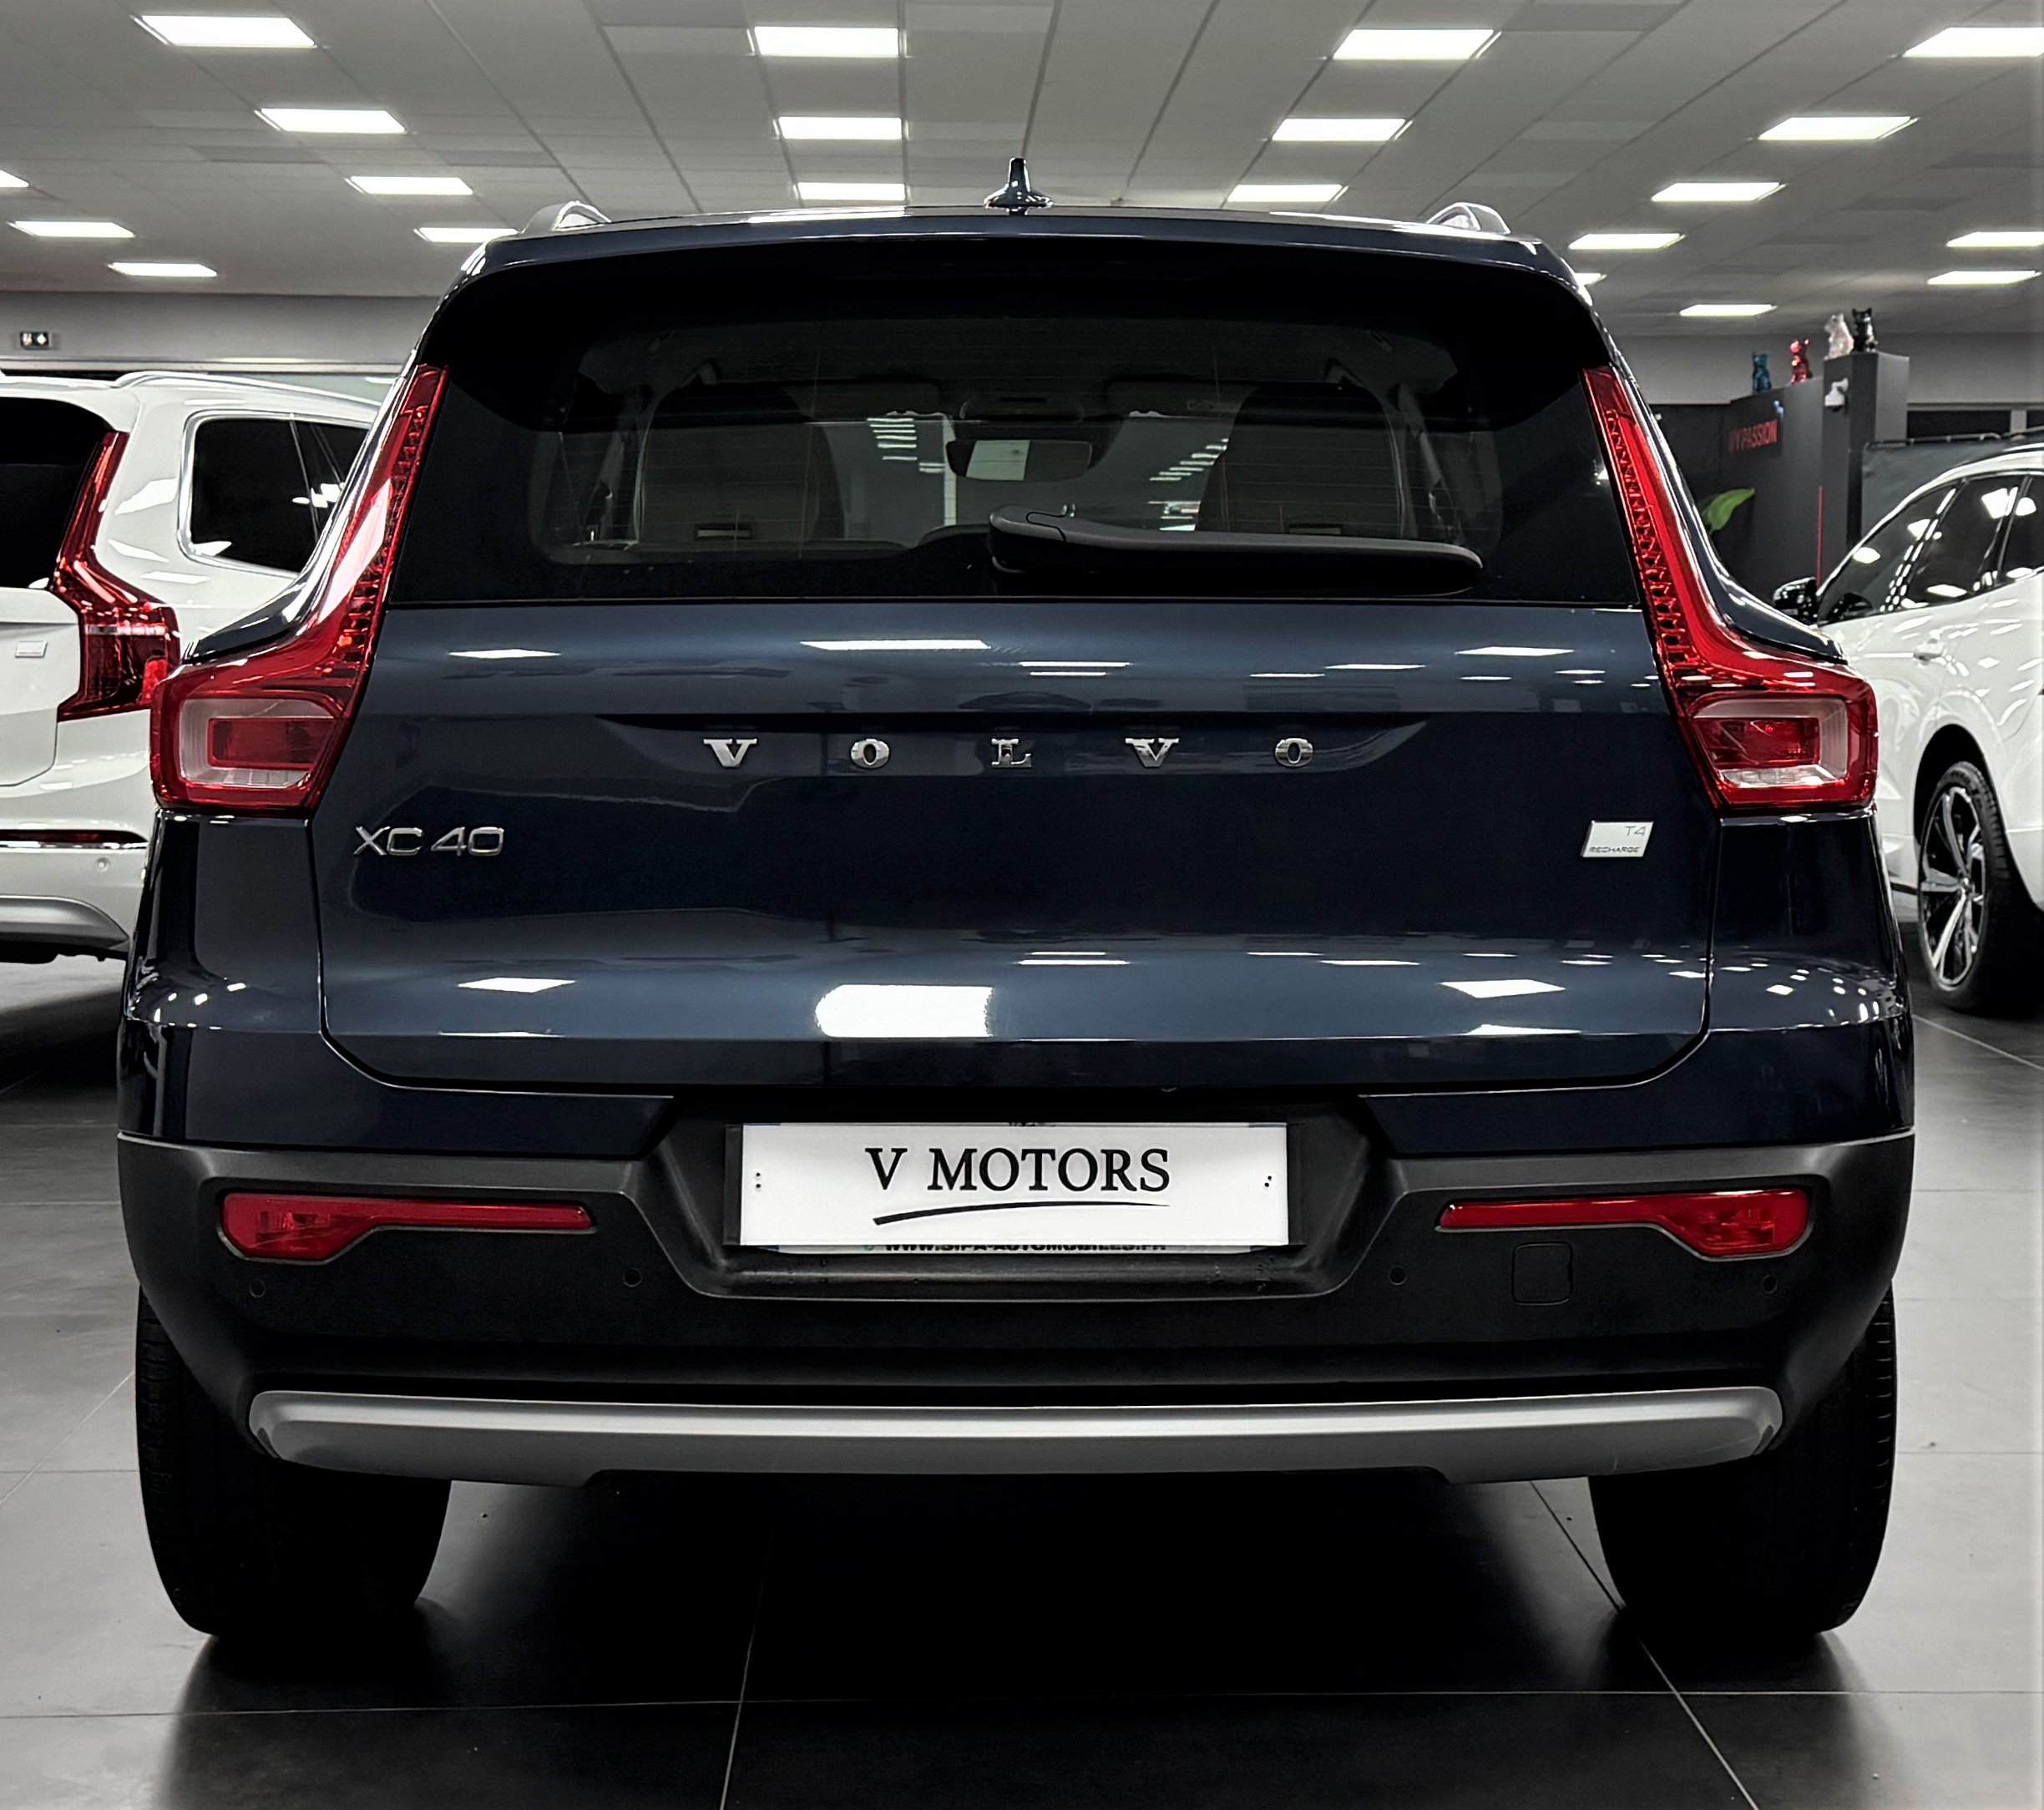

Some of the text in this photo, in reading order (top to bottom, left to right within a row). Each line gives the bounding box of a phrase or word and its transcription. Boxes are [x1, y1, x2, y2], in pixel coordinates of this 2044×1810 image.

[703, 737, 1313, 768] VOLVO
[1625, 825, 1647, 837] T4
[864, 1147, 1171, 1192] V MOTORS
